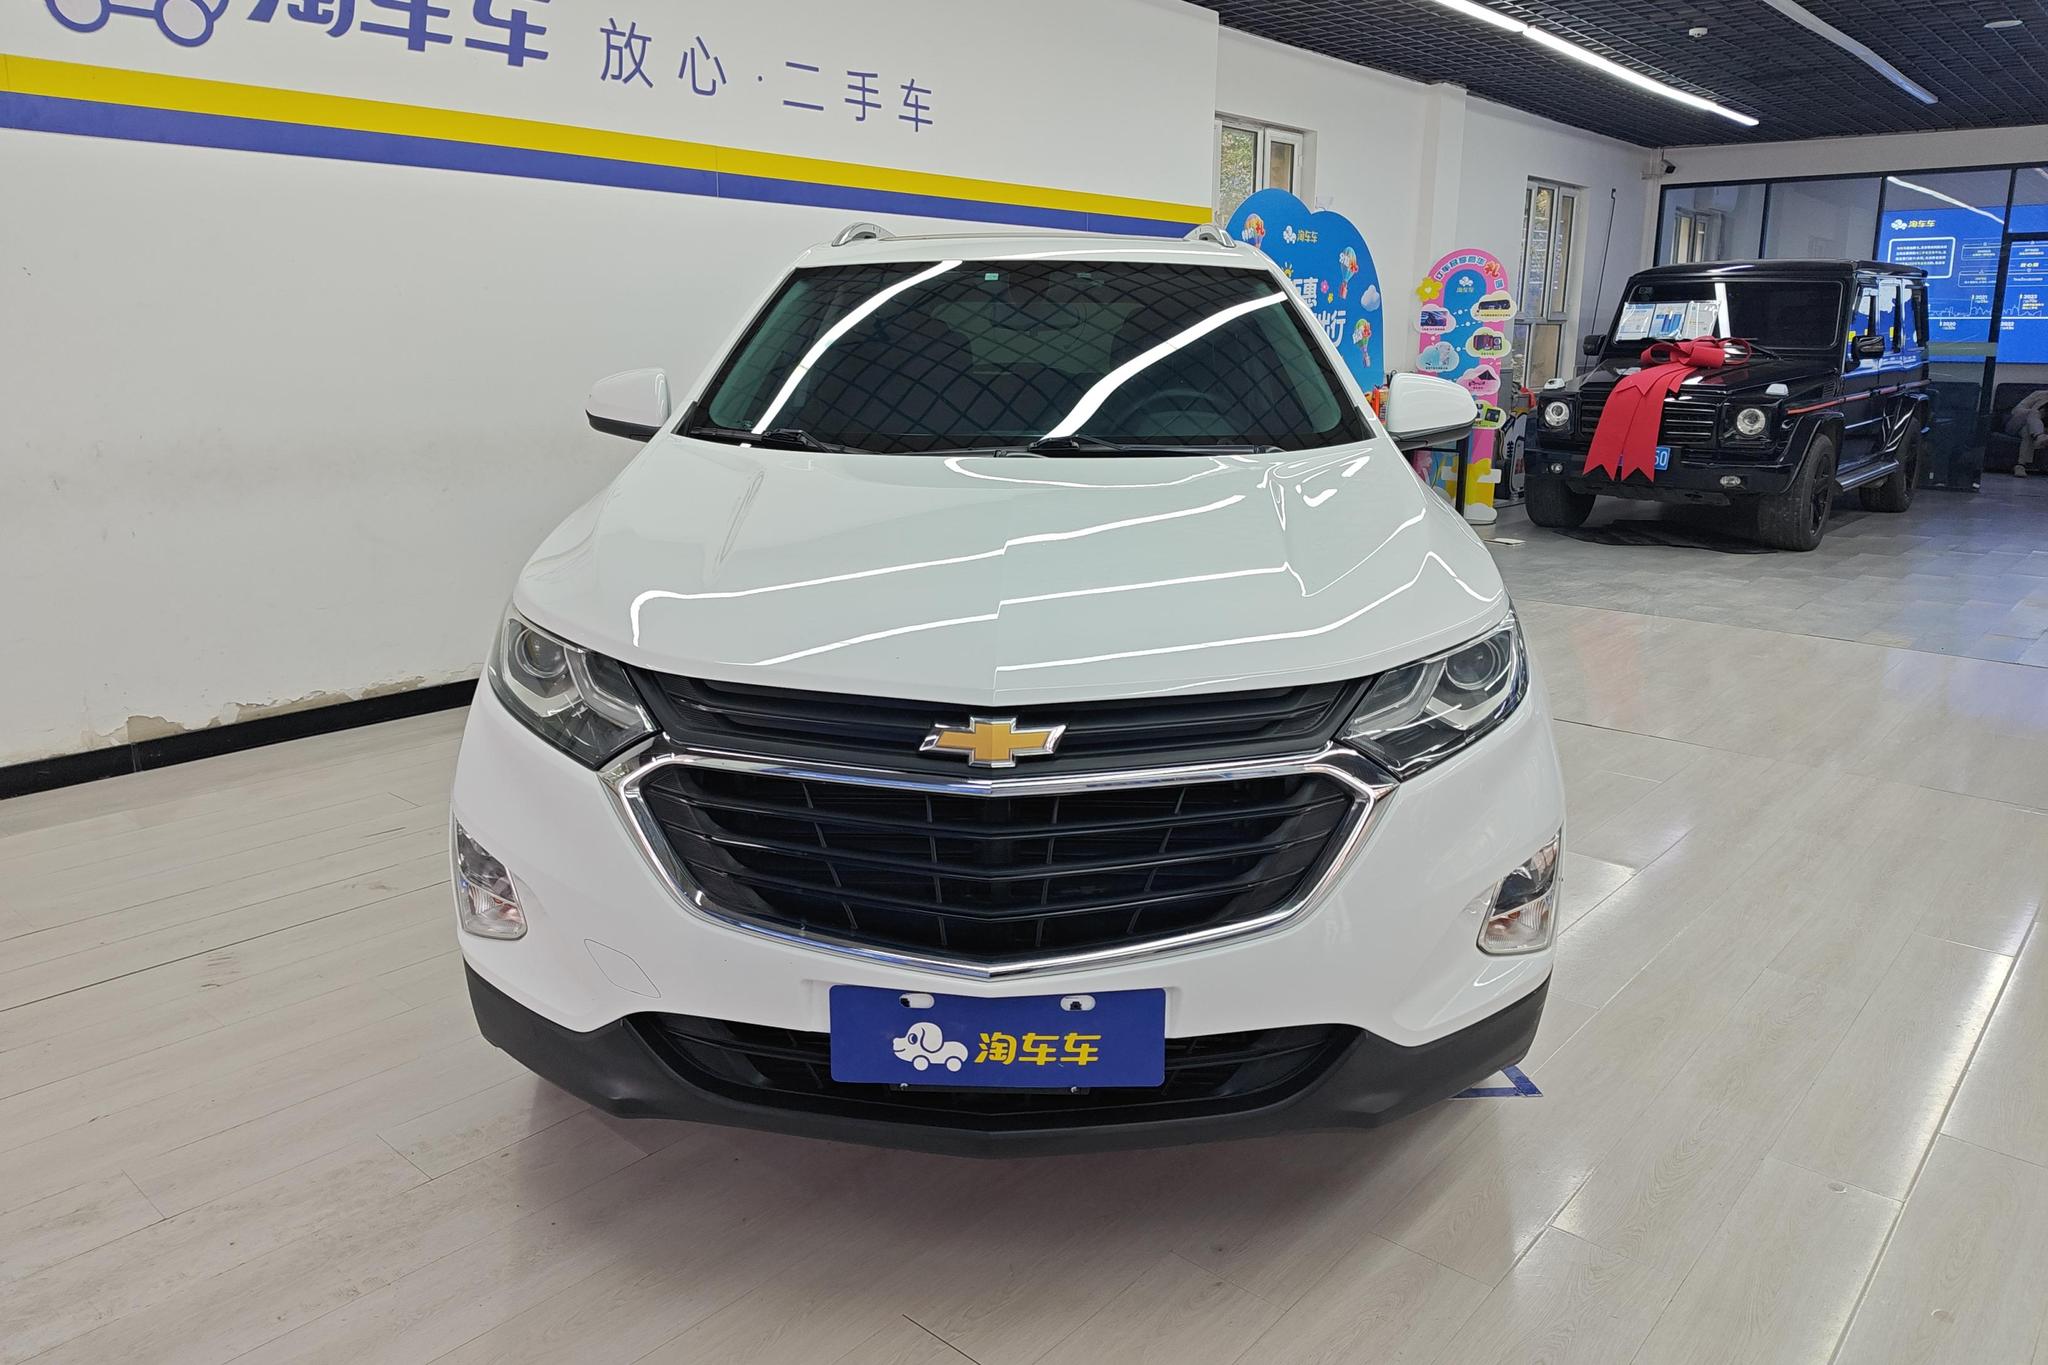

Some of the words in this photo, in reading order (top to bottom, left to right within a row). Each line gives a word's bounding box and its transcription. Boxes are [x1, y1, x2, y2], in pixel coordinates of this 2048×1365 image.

[1296, 229, 1319, 244] 淘车车
[973, 1032, 1102, 1066] 淘车车
